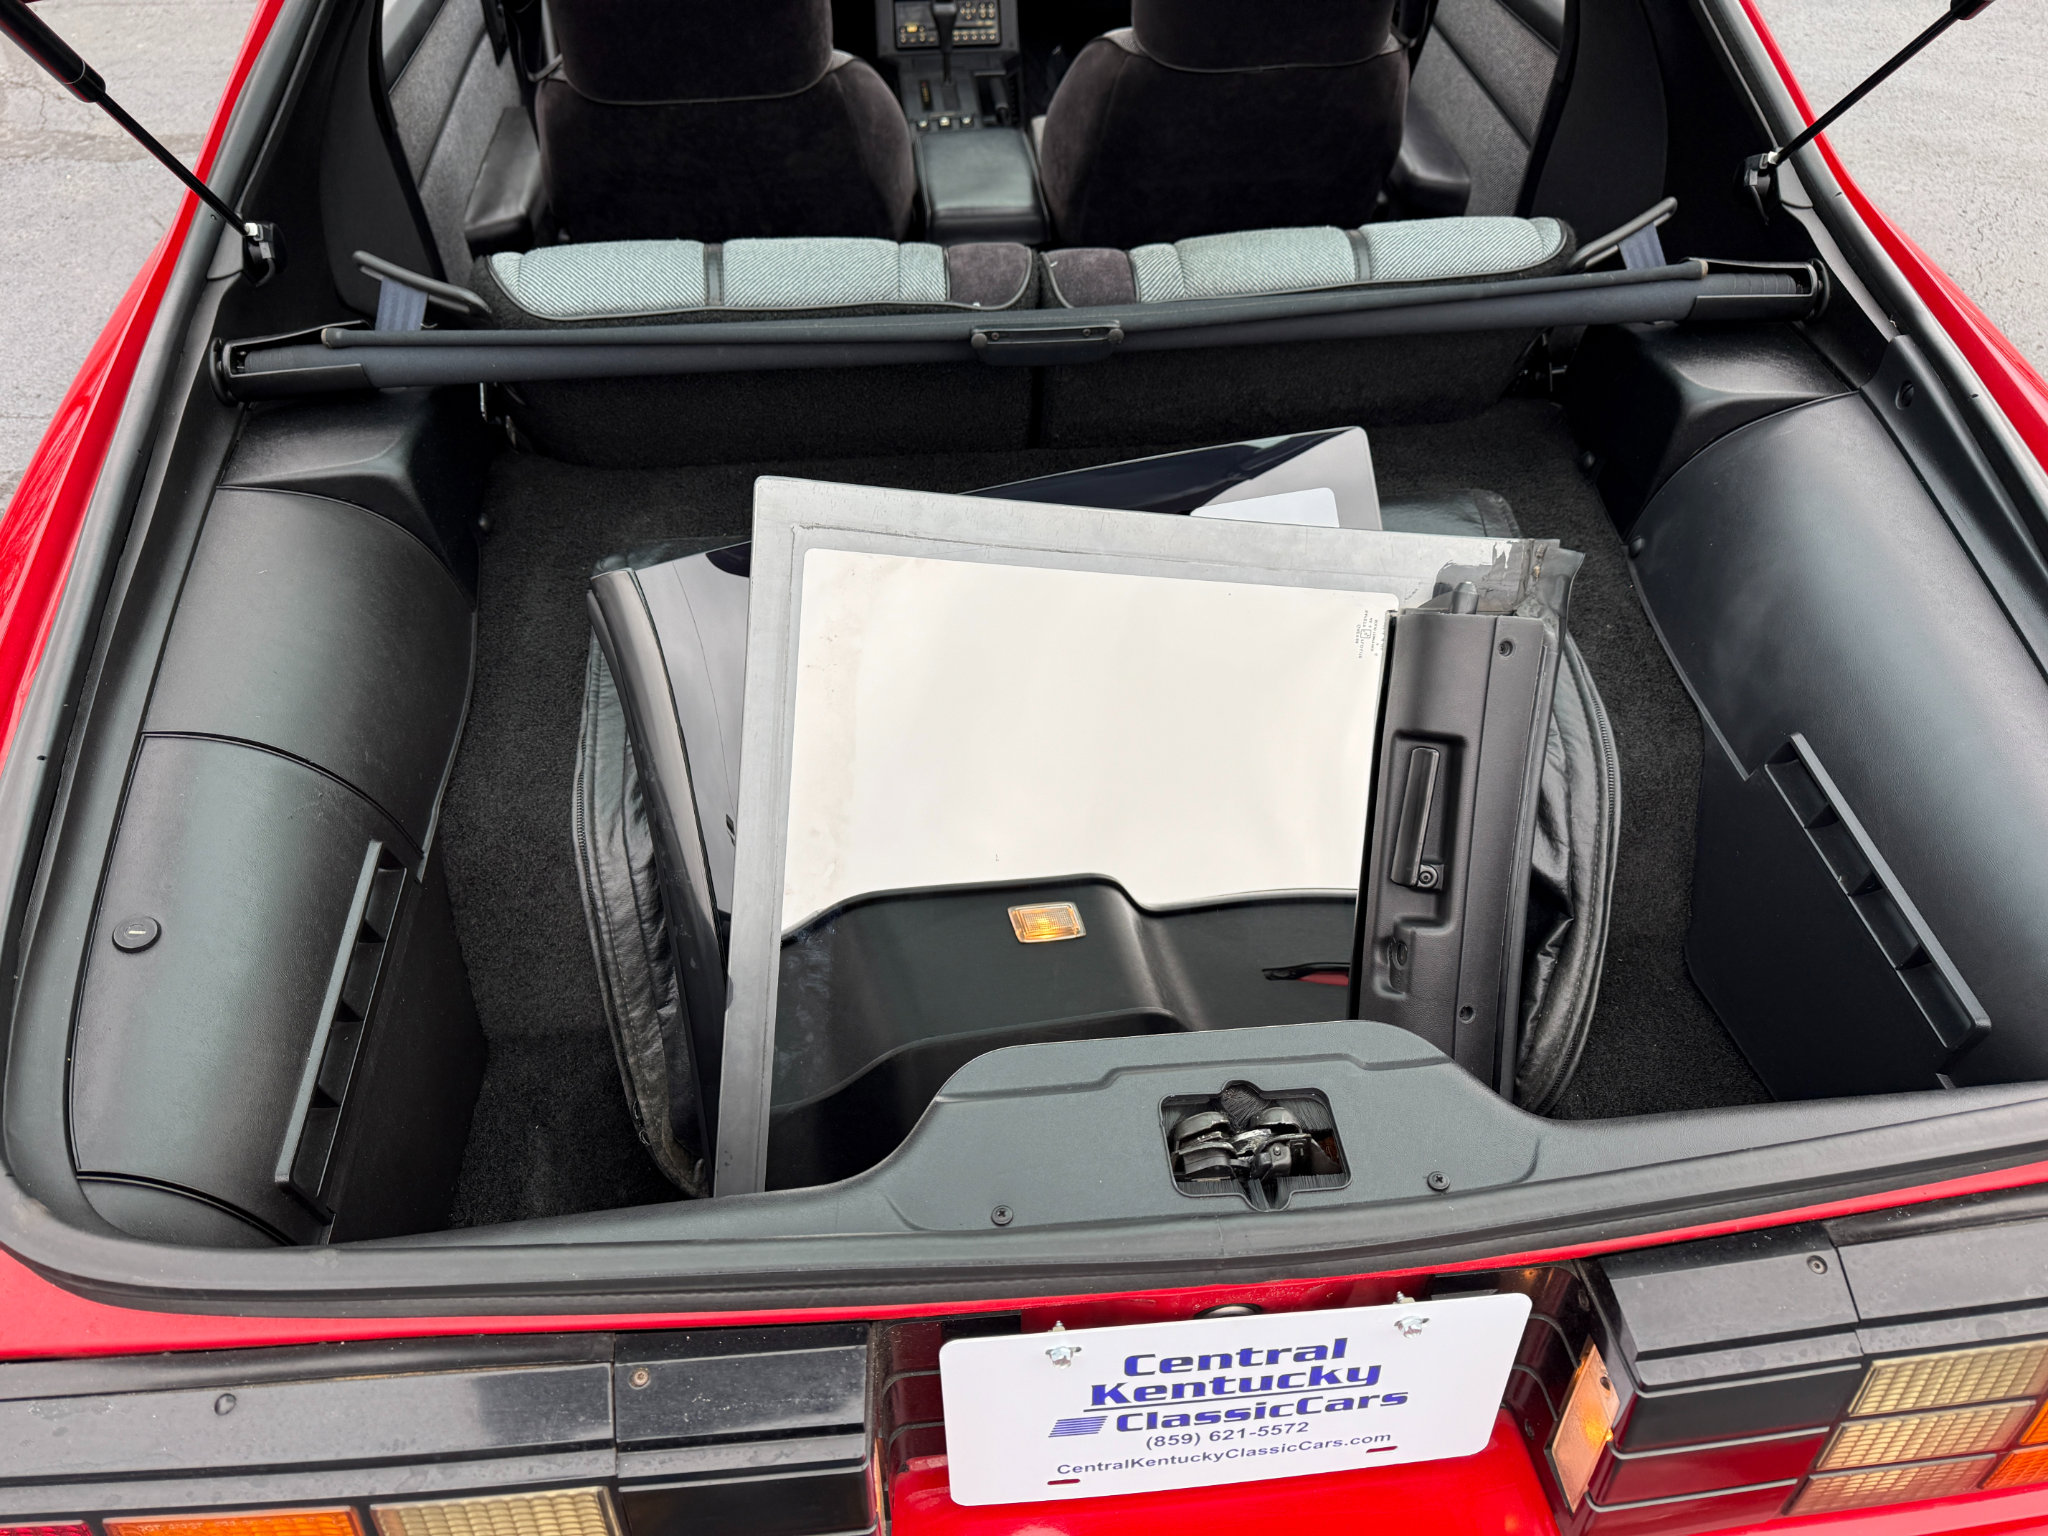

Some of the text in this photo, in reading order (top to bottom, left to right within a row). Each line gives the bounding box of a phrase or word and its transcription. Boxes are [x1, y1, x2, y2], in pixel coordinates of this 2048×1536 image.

[1124, 1337, 1348, 1377] Central
[1091, 1364, 1382, 1406] Kentucky
[1116, 1391, 1409, 1433] ClassicCars
[1057, 1434, 1391, 1475] CentralKentuckyClassicCars.com
[1146, 1421, 1309, 1451] (859) 621-5572
